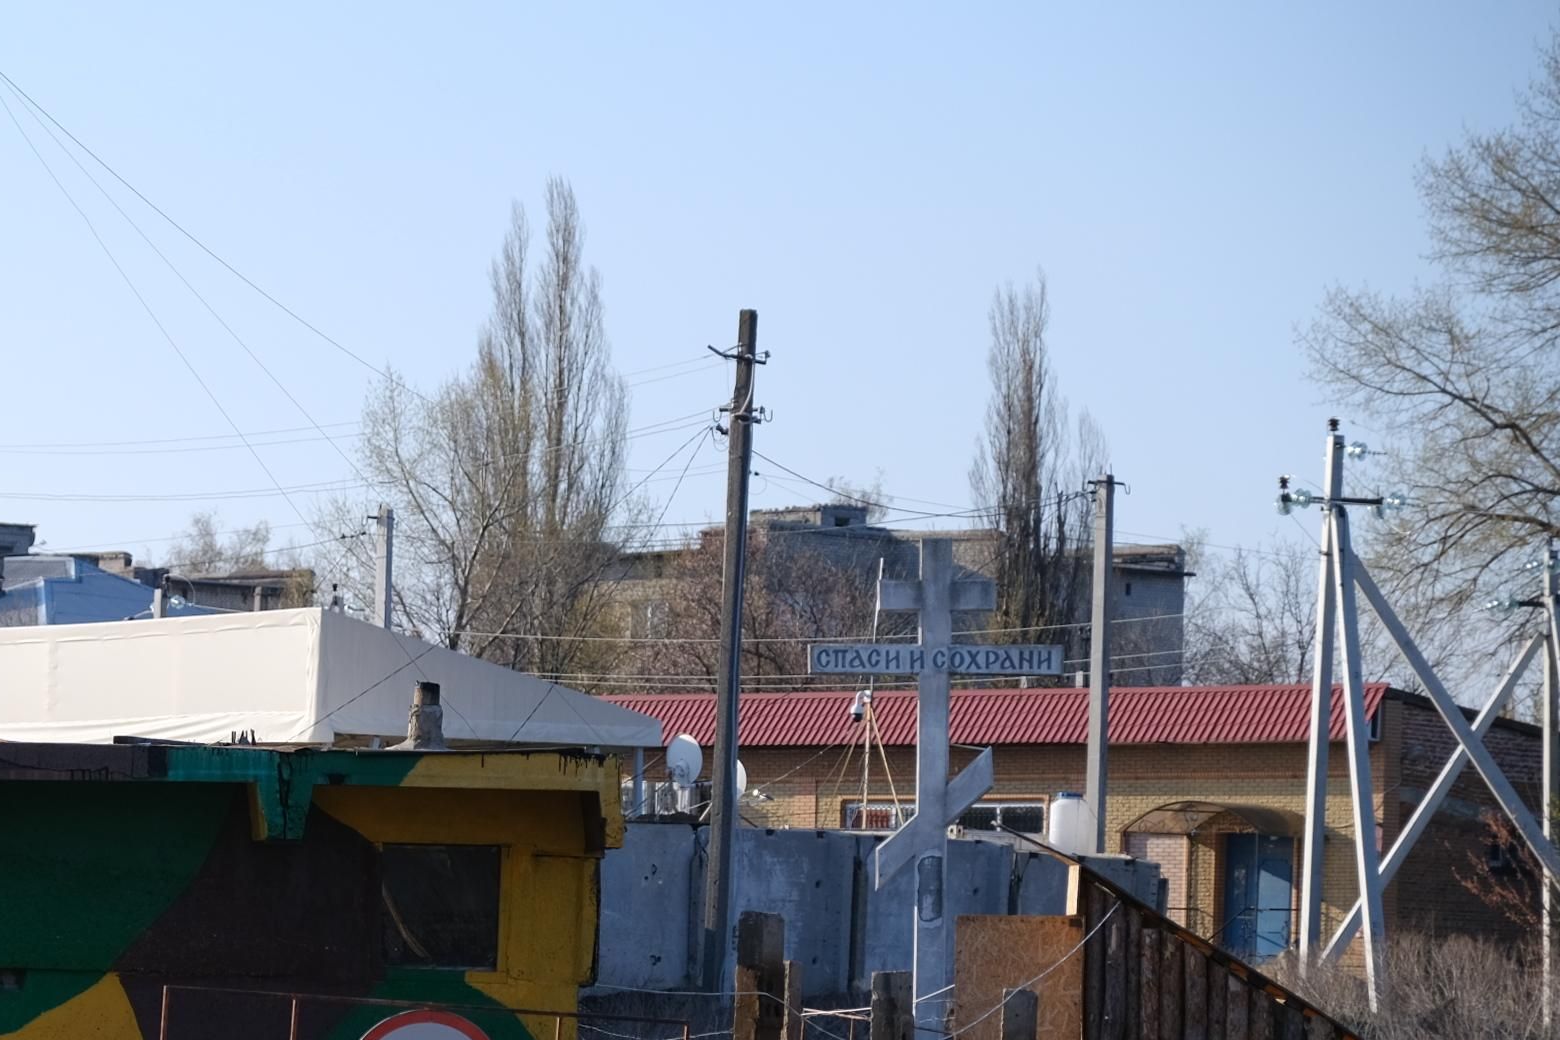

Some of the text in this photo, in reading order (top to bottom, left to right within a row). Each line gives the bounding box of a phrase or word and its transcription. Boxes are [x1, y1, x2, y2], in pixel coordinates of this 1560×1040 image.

[815, 647, 1053, 671] СПАСИ И СОХРАНИ
